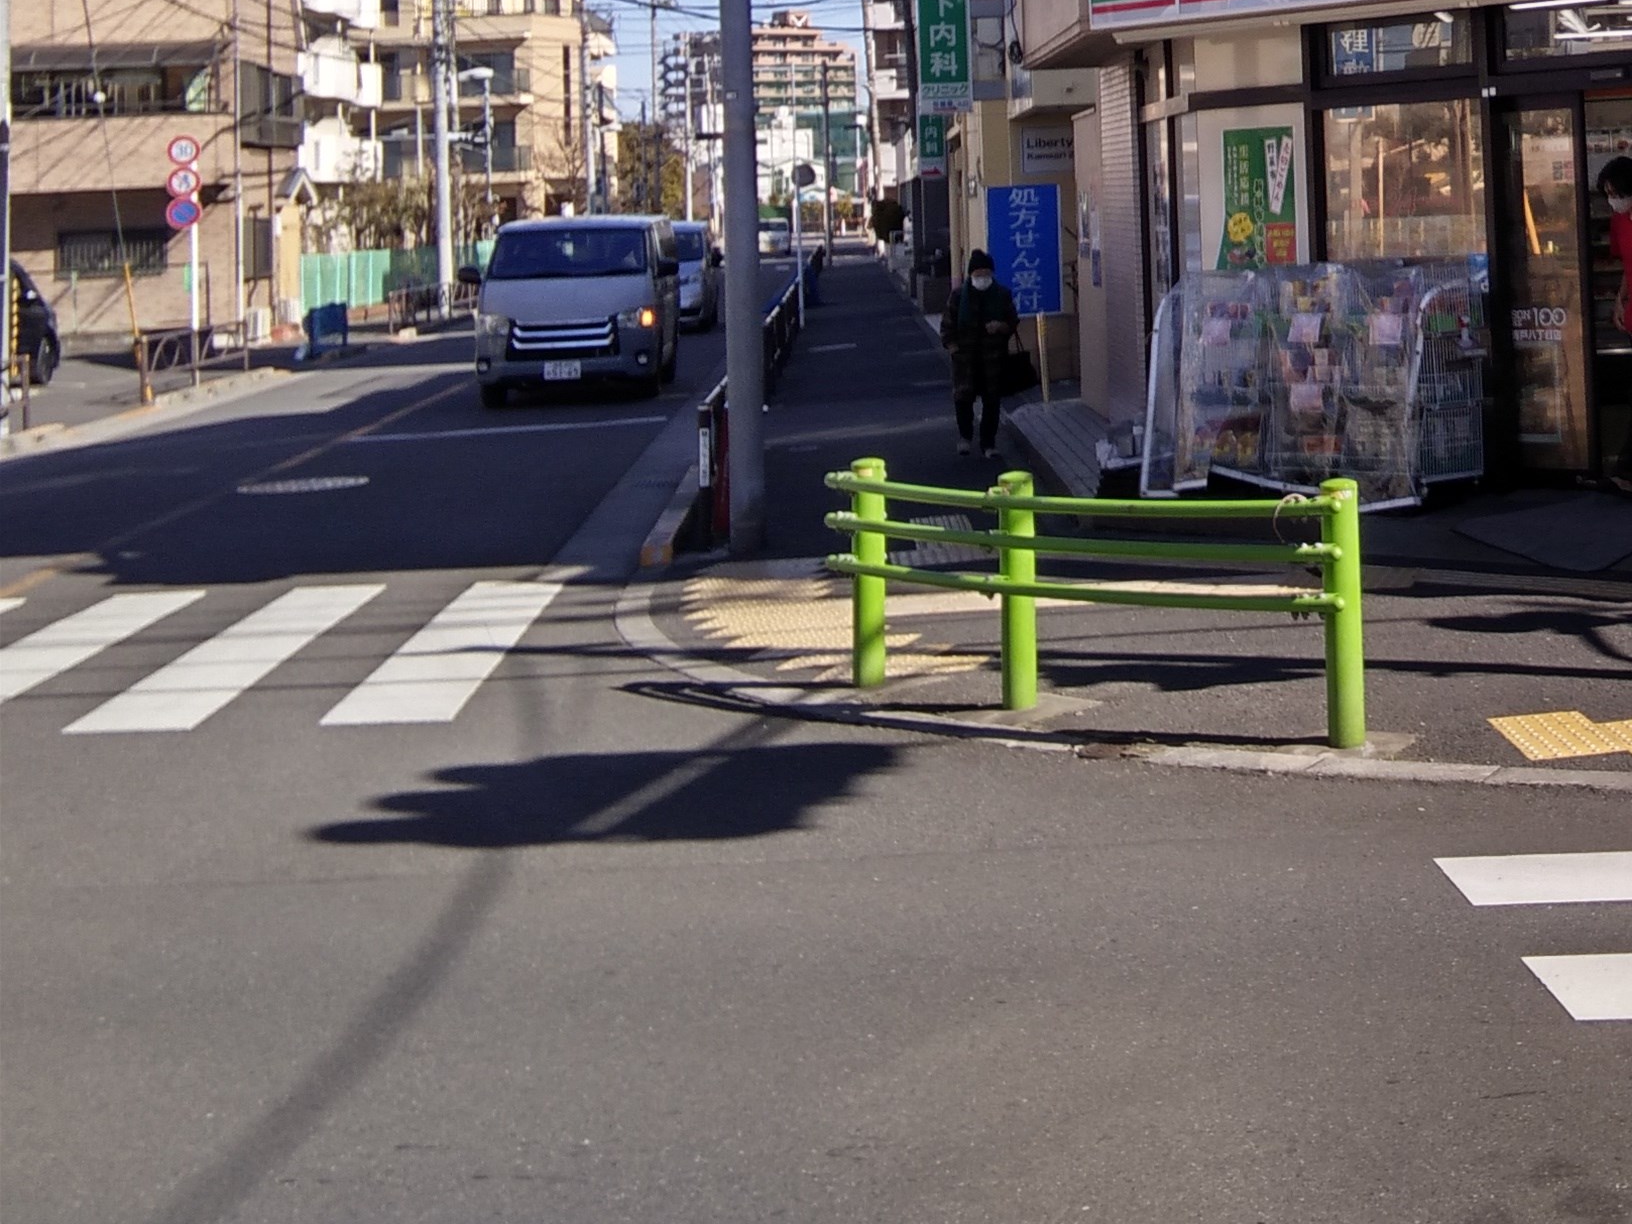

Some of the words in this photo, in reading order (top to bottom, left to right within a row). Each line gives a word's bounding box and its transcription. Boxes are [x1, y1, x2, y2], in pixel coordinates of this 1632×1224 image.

[1009, 188, 1042, 311] 処方せん受付
[1533, 307, 1566, 326] 100
